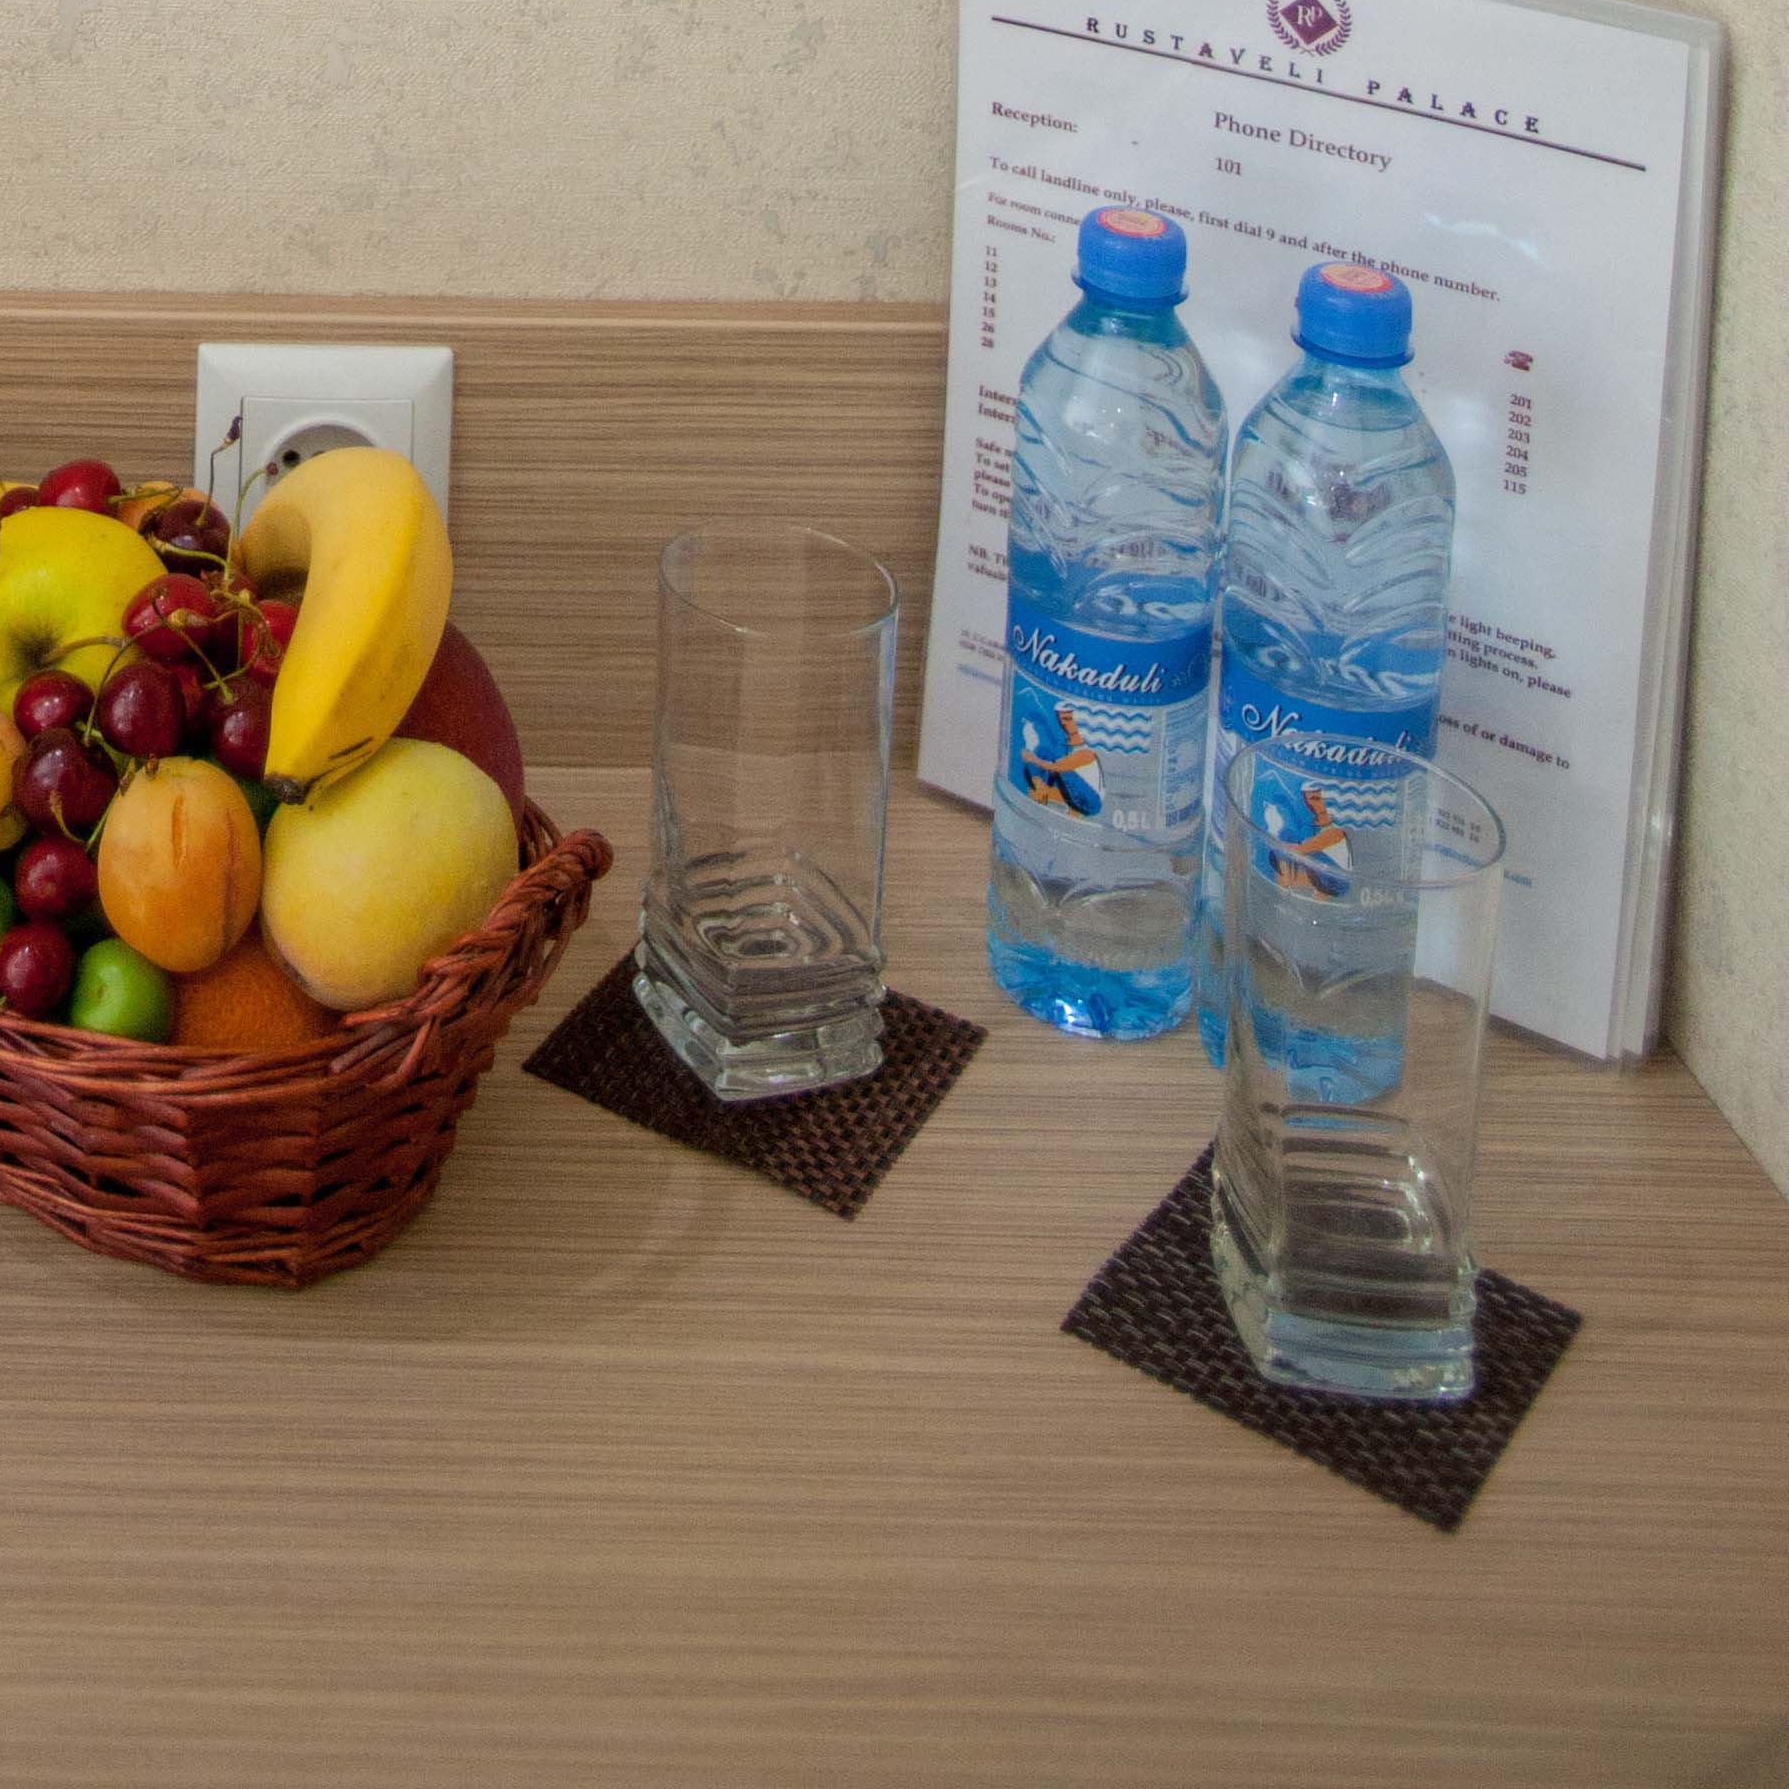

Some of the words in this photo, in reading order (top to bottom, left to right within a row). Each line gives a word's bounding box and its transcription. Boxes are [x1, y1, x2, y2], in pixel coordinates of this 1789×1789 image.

[1086, 17, 1325, 84] RUSTAVELI
[1367, 79, 1540, 134] PALACE
[991, 101, 1078, 134] Reception:
[1215, 157, 1242, 176] 101
[1213, 111, 1282, 142] Phone
[1289, 128, 1393, 172] Directory
[1010, 201, 1042, 216] room
[987, 214, 1027, 235] Rooms
[989, 156, 1009, 171] To
[1012, 161, 1036, 180] call
[1041, 169, 1099, 196] landline
[1103, 188, 1140, 208] only,
[1145, 198, 1195, 222] please,
[1198, 210, 1229, 229] first
[1233, 220, 1262, 238] dial
[1266, 227, 1275, 241] 9
[1279, 232, 1308, 250] and
[1312, 241, 1347, 261] after
[1351, 250, 1376, 269] the
[1380, 260, 1429, 284] phone
[1433, 274, 1501, 303] number.
[985, 245, 997, 257] 11
[985, 260, 998, 273] 12
[983, 291, 996, 303] 14
[1510, 393, 1532, 410] 201
[1508, 410, 1532, 427] 202
[1507, 427, 1531, 444] 203
[976, 437, 1001, 454] Safe
[1506, 445, 1529, 462] 204
[975, 453, 991, 466] To
[1504, 462, 1528, 478] 205
[973, 483, 989, 496] To
[1503, 479, 1527, 495] 115
[1460, 614, 1493, 635] light
[1013, 625, 1165, 694] Nakaduli
[1483, 643, 1538, 670] process.
[1460, 648, 1499, 673] lights
[1527, 675, 1571, 699] please
[1241, 703, 1410, 765] Nakaduli
[1463, 724, 1479, 736] of
[1480, 730, 1496, 742] or
[1499, 734, 1553, 764] damage
[1556, 756, 1570, 770] to
